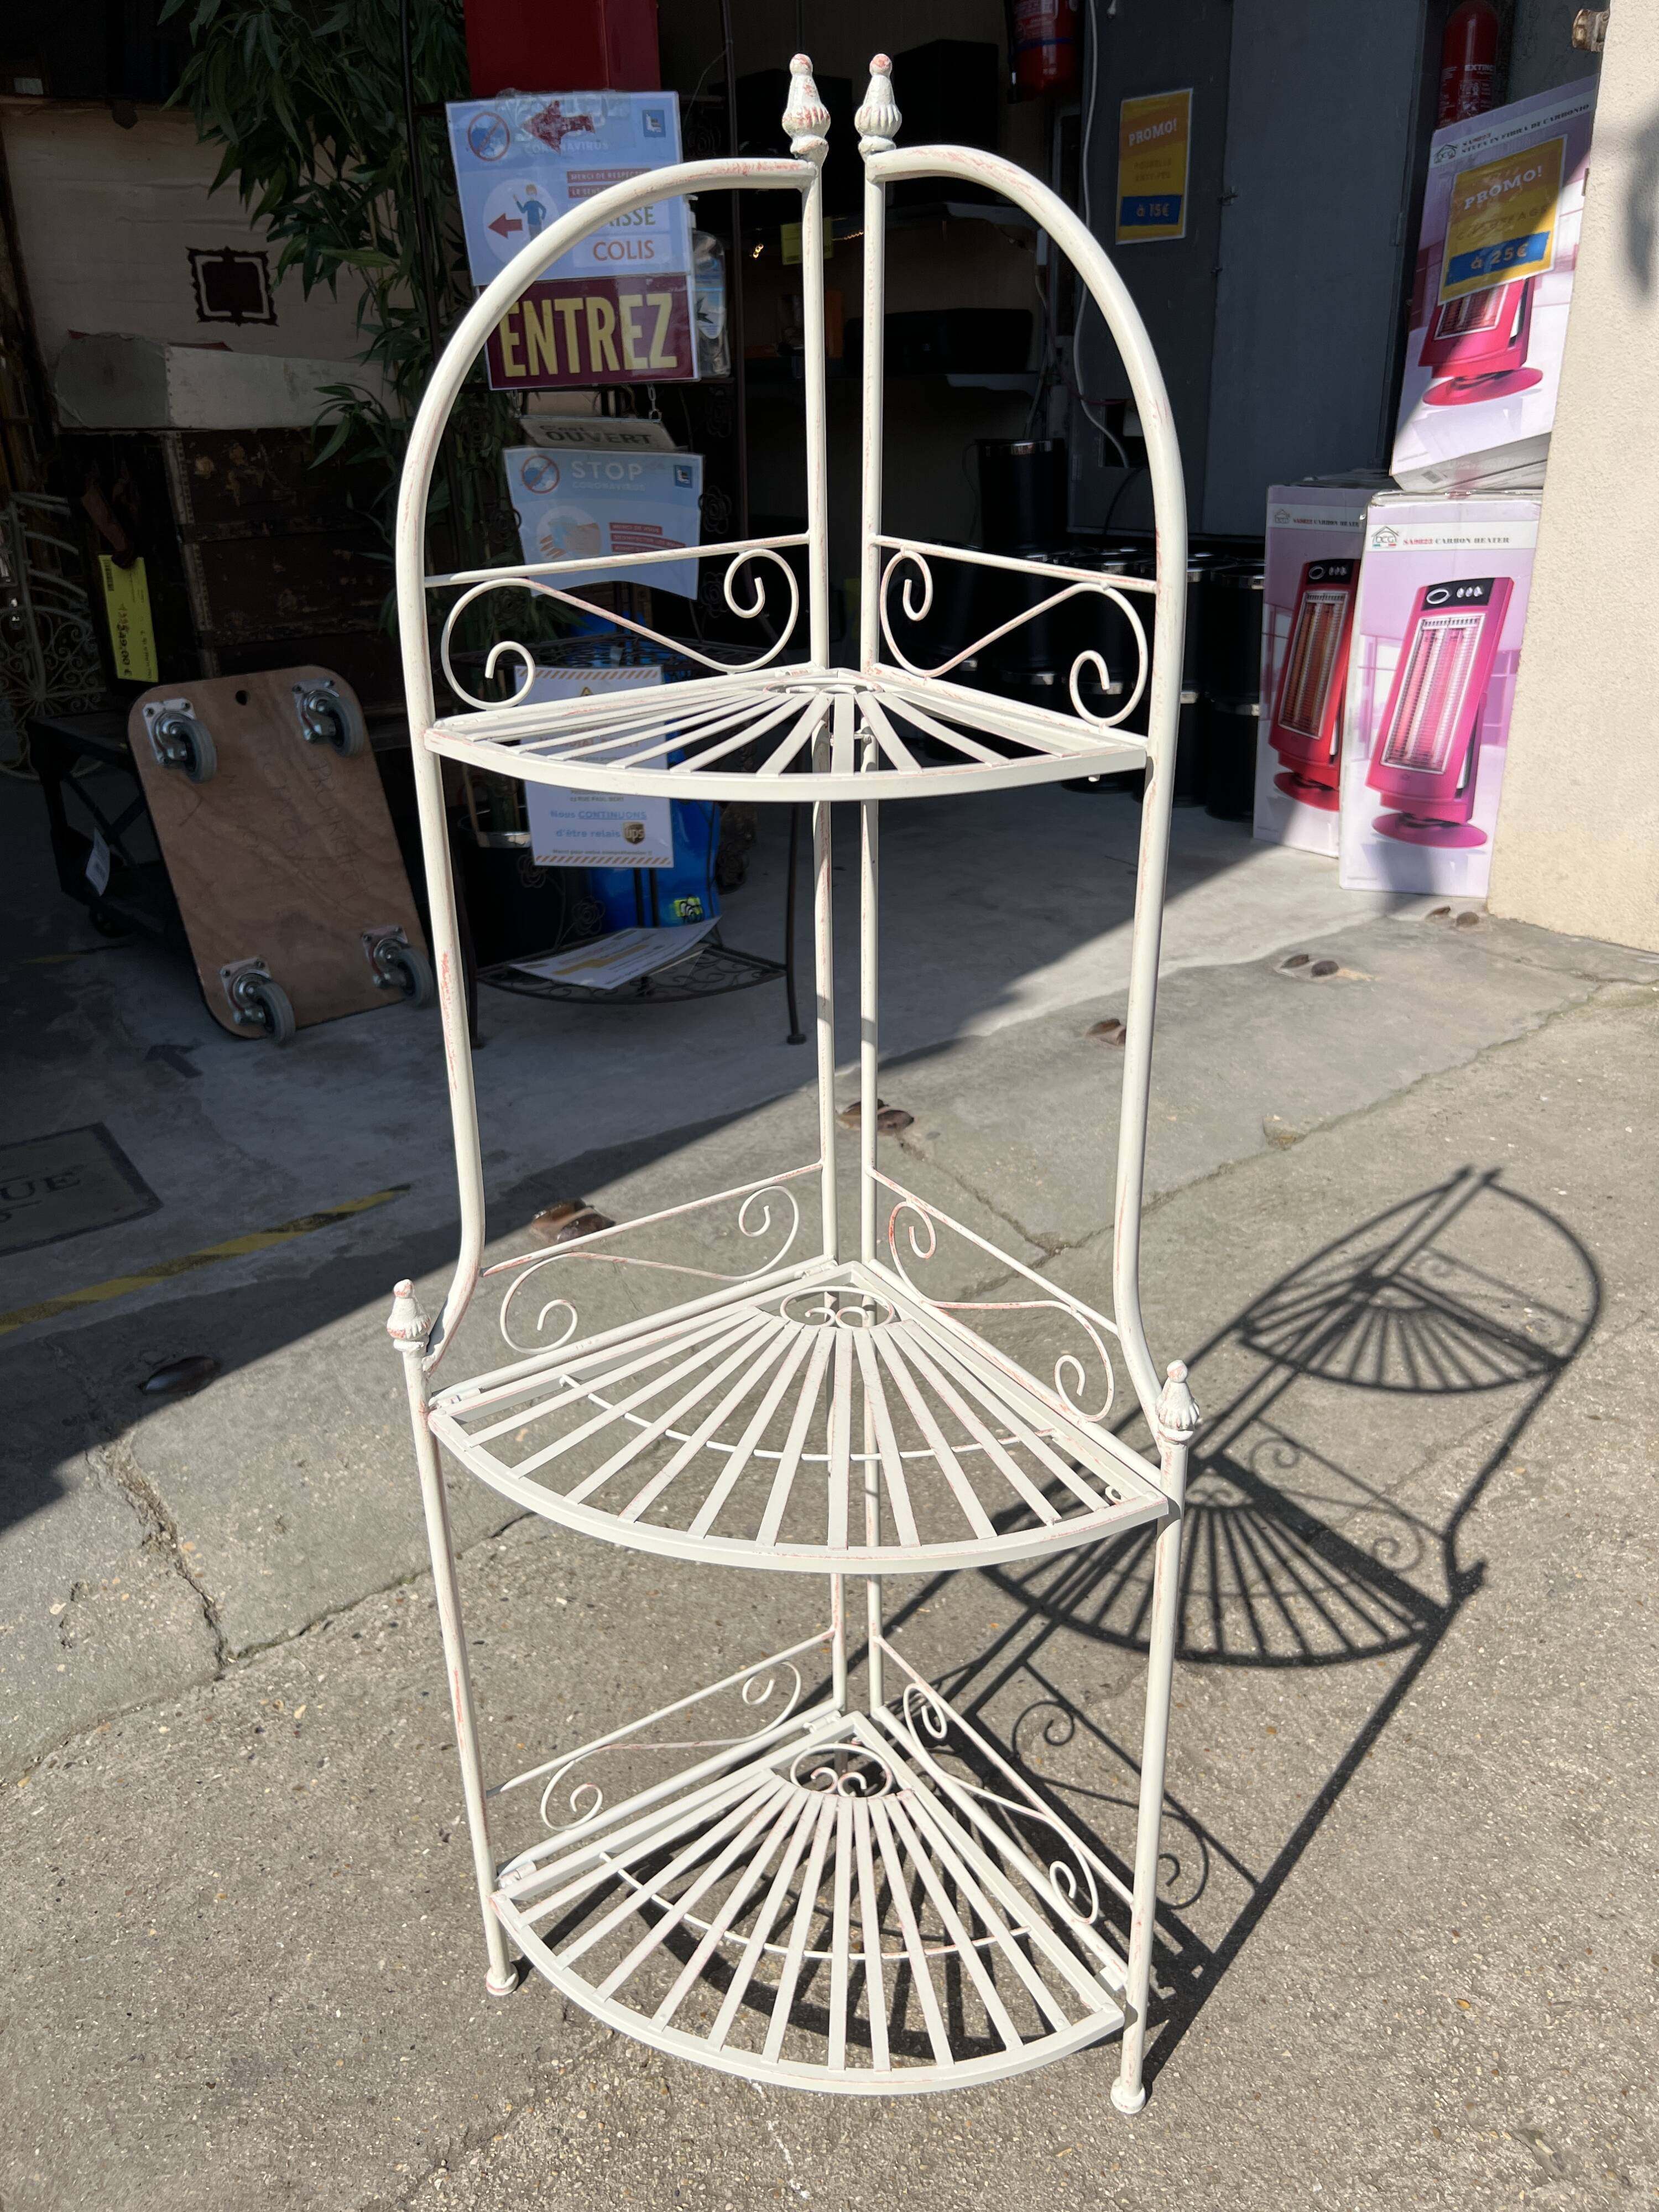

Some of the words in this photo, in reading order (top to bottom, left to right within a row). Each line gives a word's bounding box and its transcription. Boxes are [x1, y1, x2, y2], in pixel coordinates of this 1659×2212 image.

[1543, 104, 1589, 124] CARBONIO
[1128, 118, 1177, 147] PROMO!
[1464, 165, 1542, 210] PROMO!
[1149, 202, 1171, 217] 15€
[593, 239, 655, 261] COLIS
[1490, 242, 1528, 265] 25€
[499, 293, 678, 377] ENTREZ
[545, 431, 652, 444] OUVERT
[571, 461, 643, 481] STOP
[550, 810, 576, 818] Nous
[578, 810, 646, 820] CONTINUONS
[556, 828, 587, 837] d'être
[625, 828, 645, 842] ups
